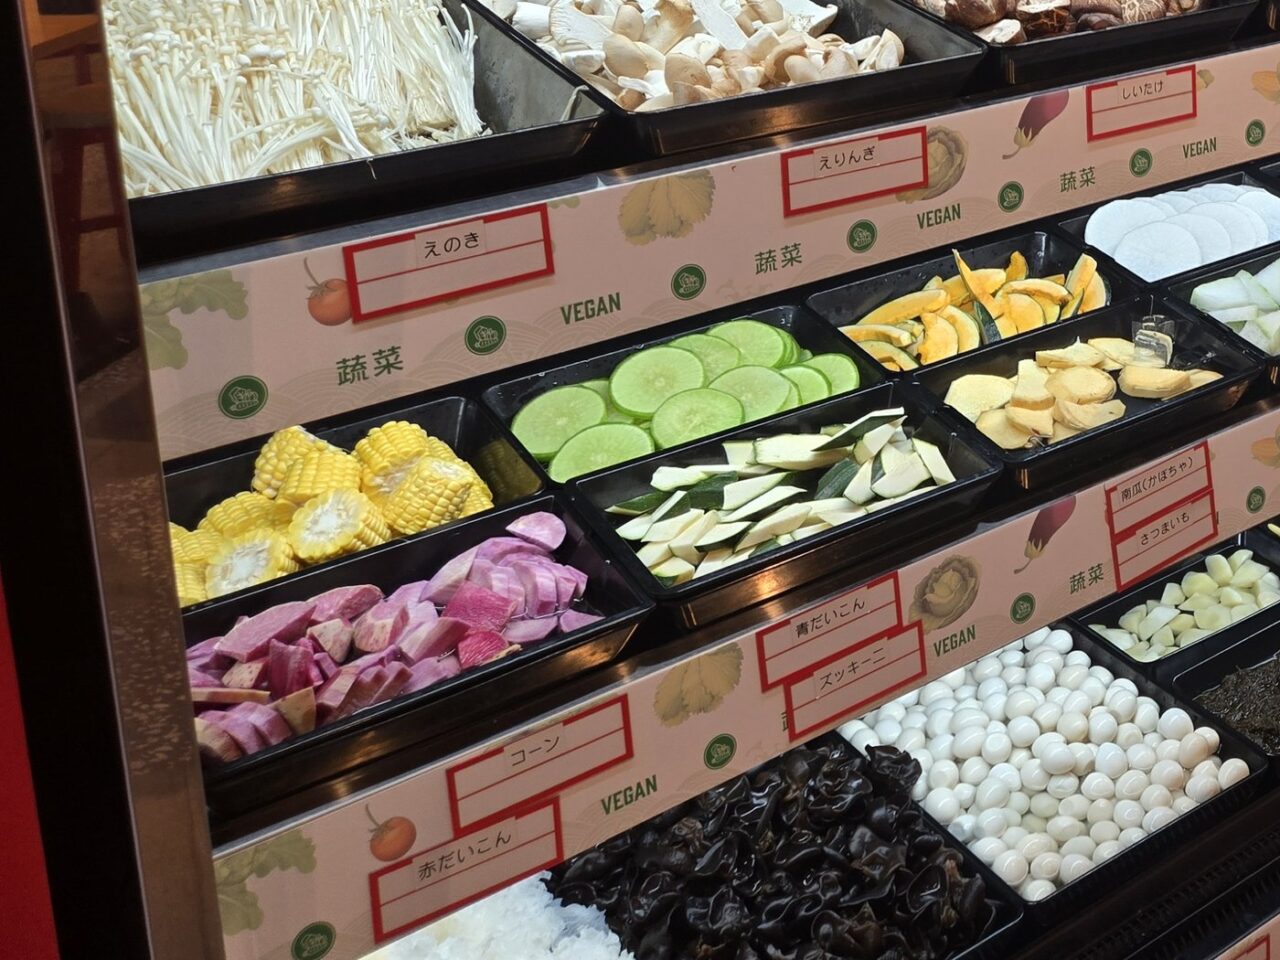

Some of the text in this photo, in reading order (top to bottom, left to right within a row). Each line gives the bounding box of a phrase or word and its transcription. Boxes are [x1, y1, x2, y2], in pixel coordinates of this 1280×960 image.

[1122, 80, 1164, 99] しいたけ
[819, 145, 876, 171] えりんぎ
[1182, 138, 1217, 158] VEGAN
[1059, 166, 1096, 193] 蔬菜
[916, 203, 962, 229] VEGAN
[424, 231, 481, 259] えのき
[755, 242, 803, 275] 蔬菜
[560, 293, 622, 326] VEGAN
[335, 347, 404, 386] 蔬菜
[1121, 456, 1193, 502] 南瓜(かぼちゃ)
[1140, 512, 1190, 546] さつまいも
[1069, 564, 1104, 595] 蔬菜
[795, 598, 865, 638] 青だいこん
[933, 625, 976, 657] VEGAN
[820, 648, 886, 690] ズッキーニ
[511, 735, 560, 768] コーン
[601, 774, 657, 815] VEGAN
[418, 830, 512, 881] 赤だいこん
